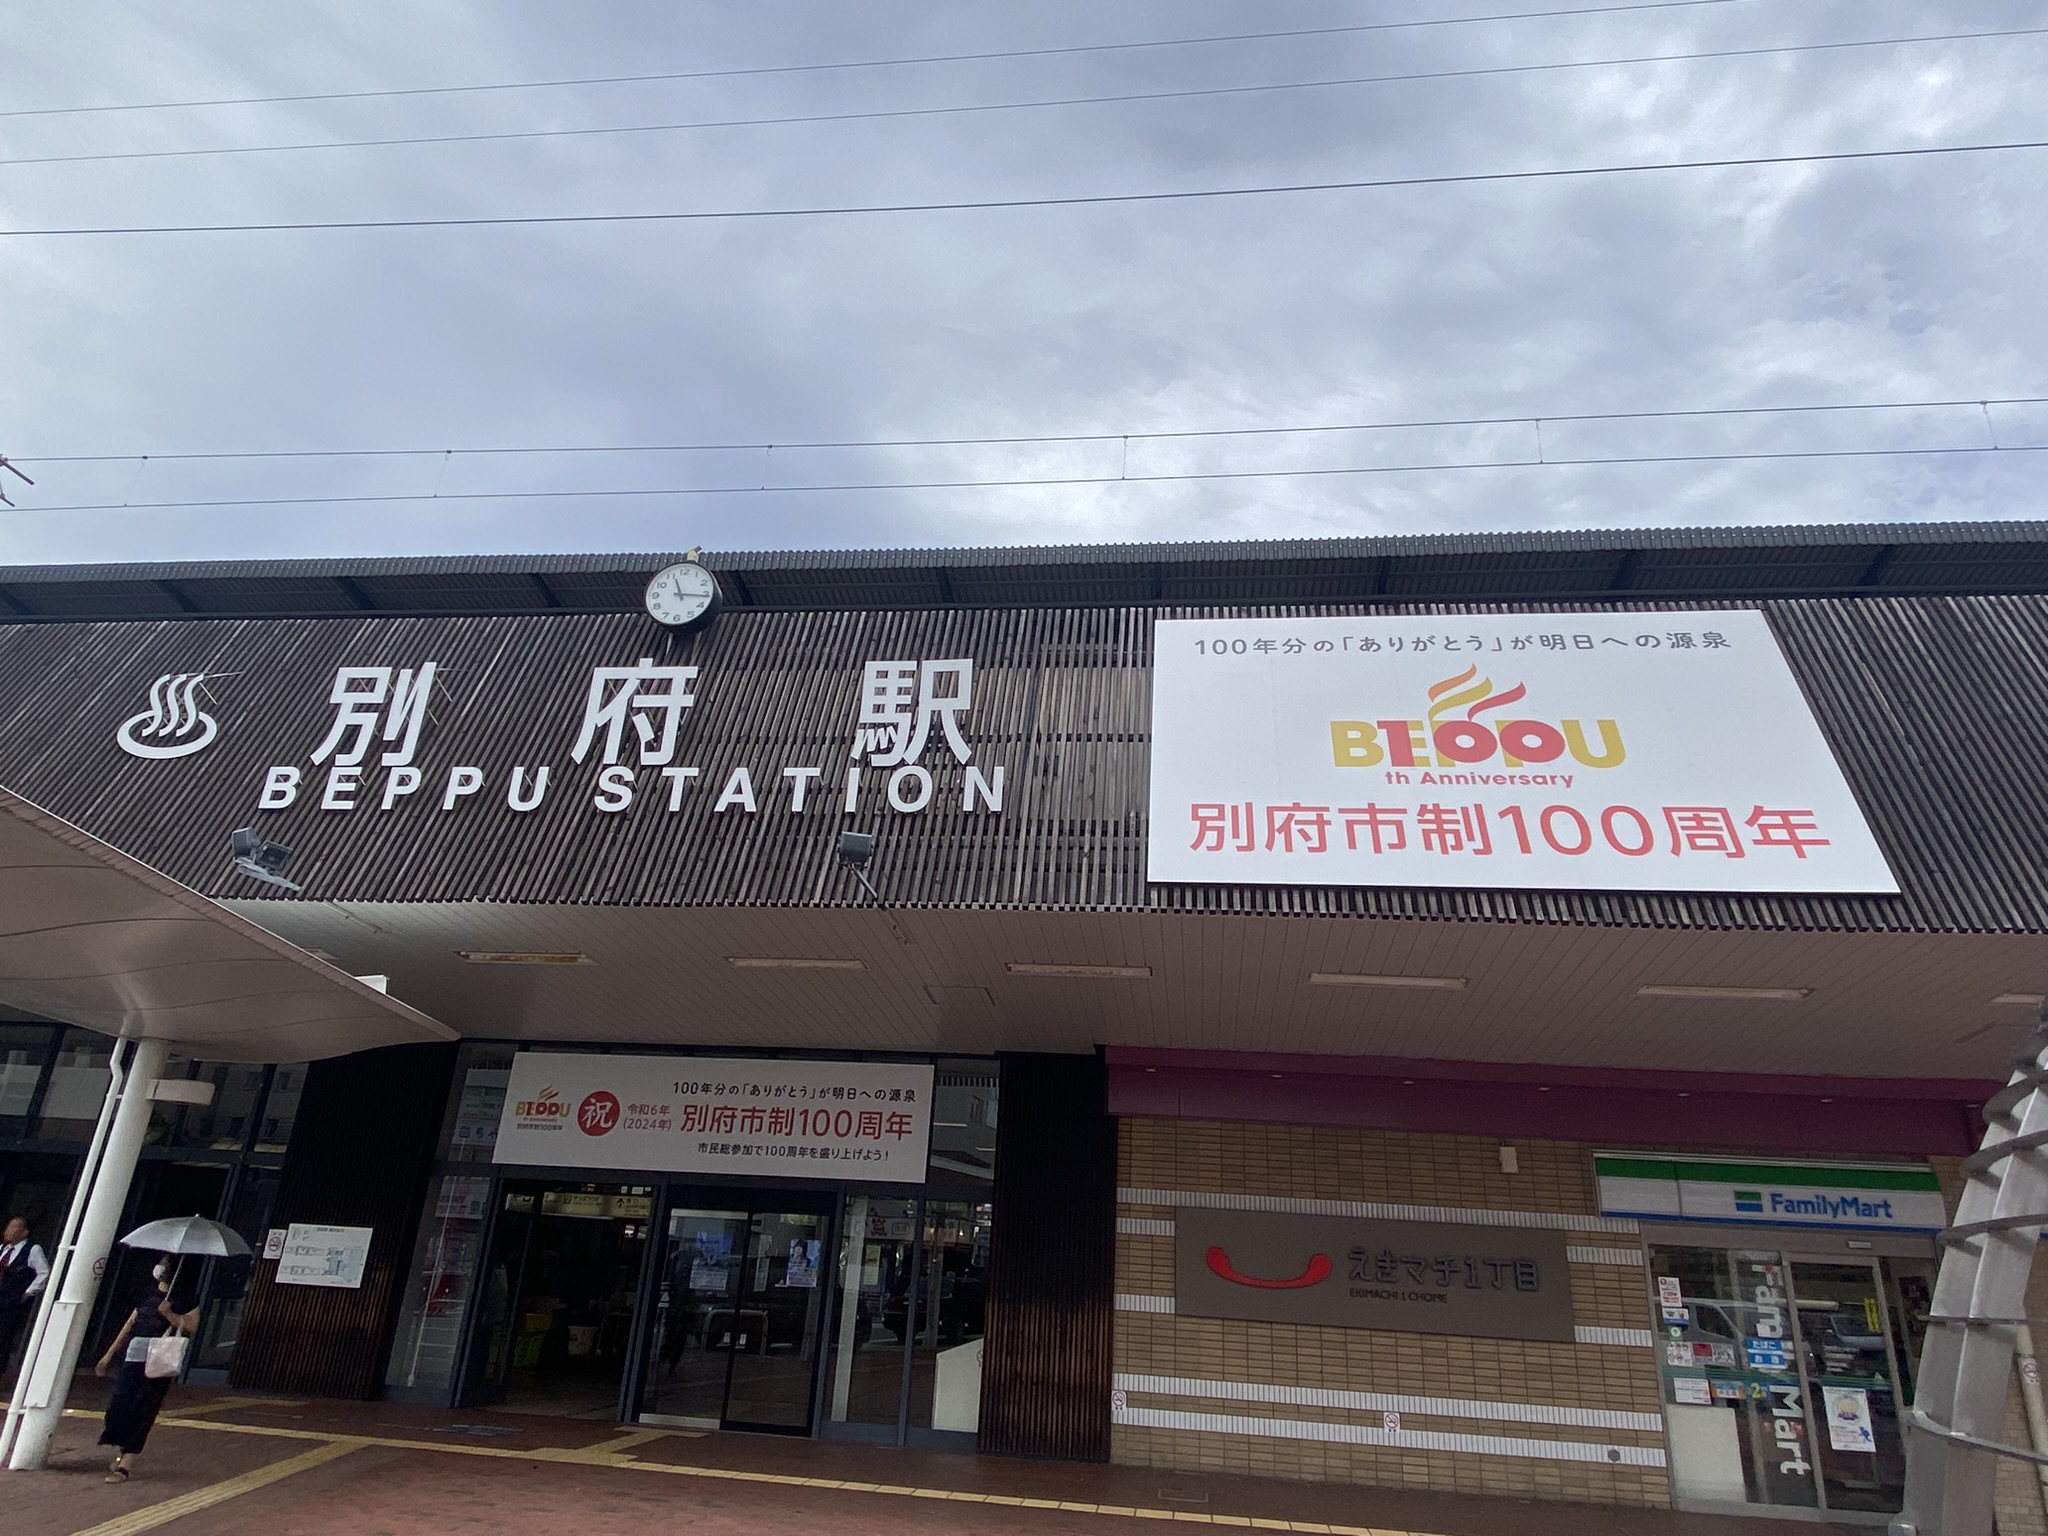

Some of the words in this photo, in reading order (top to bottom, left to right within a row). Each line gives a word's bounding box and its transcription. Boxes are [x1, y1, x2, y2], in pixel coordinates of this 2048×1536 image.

[679, 568, 690, 576] 12
[700, 579, 708, 587] 2
[652, 592, 660, 600] 9
[696, 601, 705, 609] 4
[661, 611, 670, 619] 7
[1194, 631, 1731, 655] 100年分の「ありがとう」が明日への源泉
[309, 658, 974, 767] 別府駅
[258, 766, 549, 812] BEPPU
[593, 765, 1005, 814] STATION
[1385, 771, 1410, 785] th
[1419, 771, 1574, 788] Anniversary
[1189, 801, 1831, 859] 別府市制100周年
[673, 1081, 917, 1103] 100年分の「ありがとう」が明日への源泉
[582, 1097, 614, 1130] 祝
[627, 1103, 671, 1116] 令和6年
[680, 1104, 913, 1141] 別府市制100周年
[1770, 1193, 1893, 1218] FamilyMart
[1348, 1247, 1540, 1293] えきマチ1丁目
[1349, 1287, 1399, 1301] EKIMACHI
[1408, 1290, 1448, 1304] CHOME
